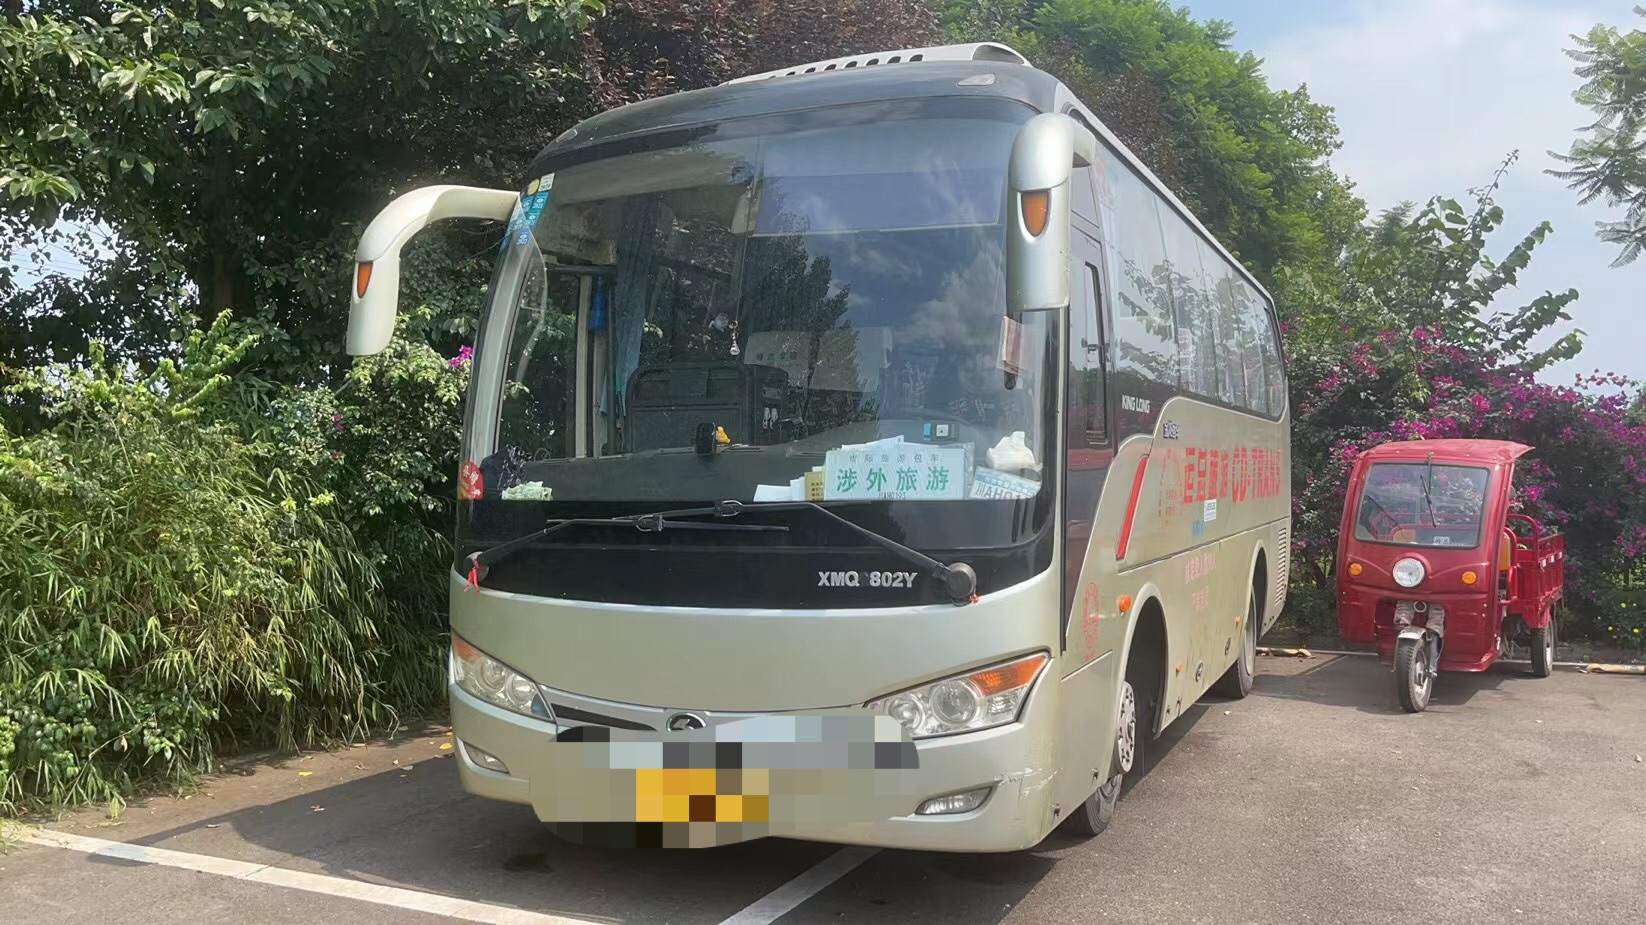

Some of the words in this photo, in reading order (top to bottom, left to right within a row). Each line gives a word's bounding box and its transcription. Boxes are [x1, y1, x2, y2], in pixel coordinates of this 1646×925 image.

[1121, 394, 1136, 411] KING
[1136, 397, 1150, 414] LONG
[837, 465, 949, 493] 涉外旅游
[818, 570, 860, 587] XMQ
[869, 571, 918, 588] 802Y
